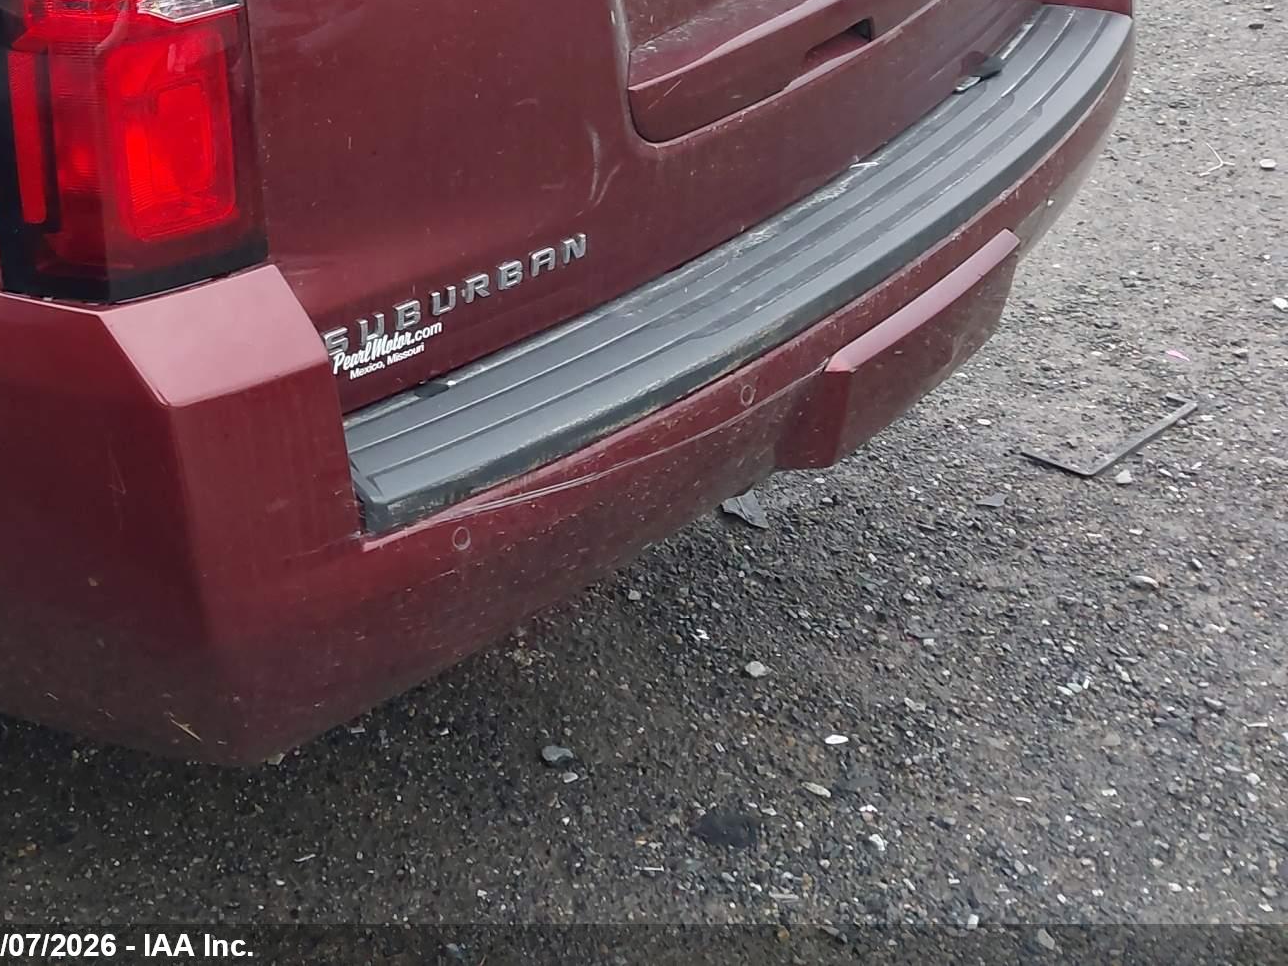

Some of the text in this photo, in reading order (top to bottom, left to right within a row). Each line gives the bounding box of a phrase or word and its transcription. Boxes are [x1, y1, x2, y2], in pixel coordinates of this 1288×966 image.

[323, 234, 587, 356] SUBURBAN
[332, 321, 443, 375] PearlMotor.com
[349, 342, 425, 380] Mexico, Missouri
